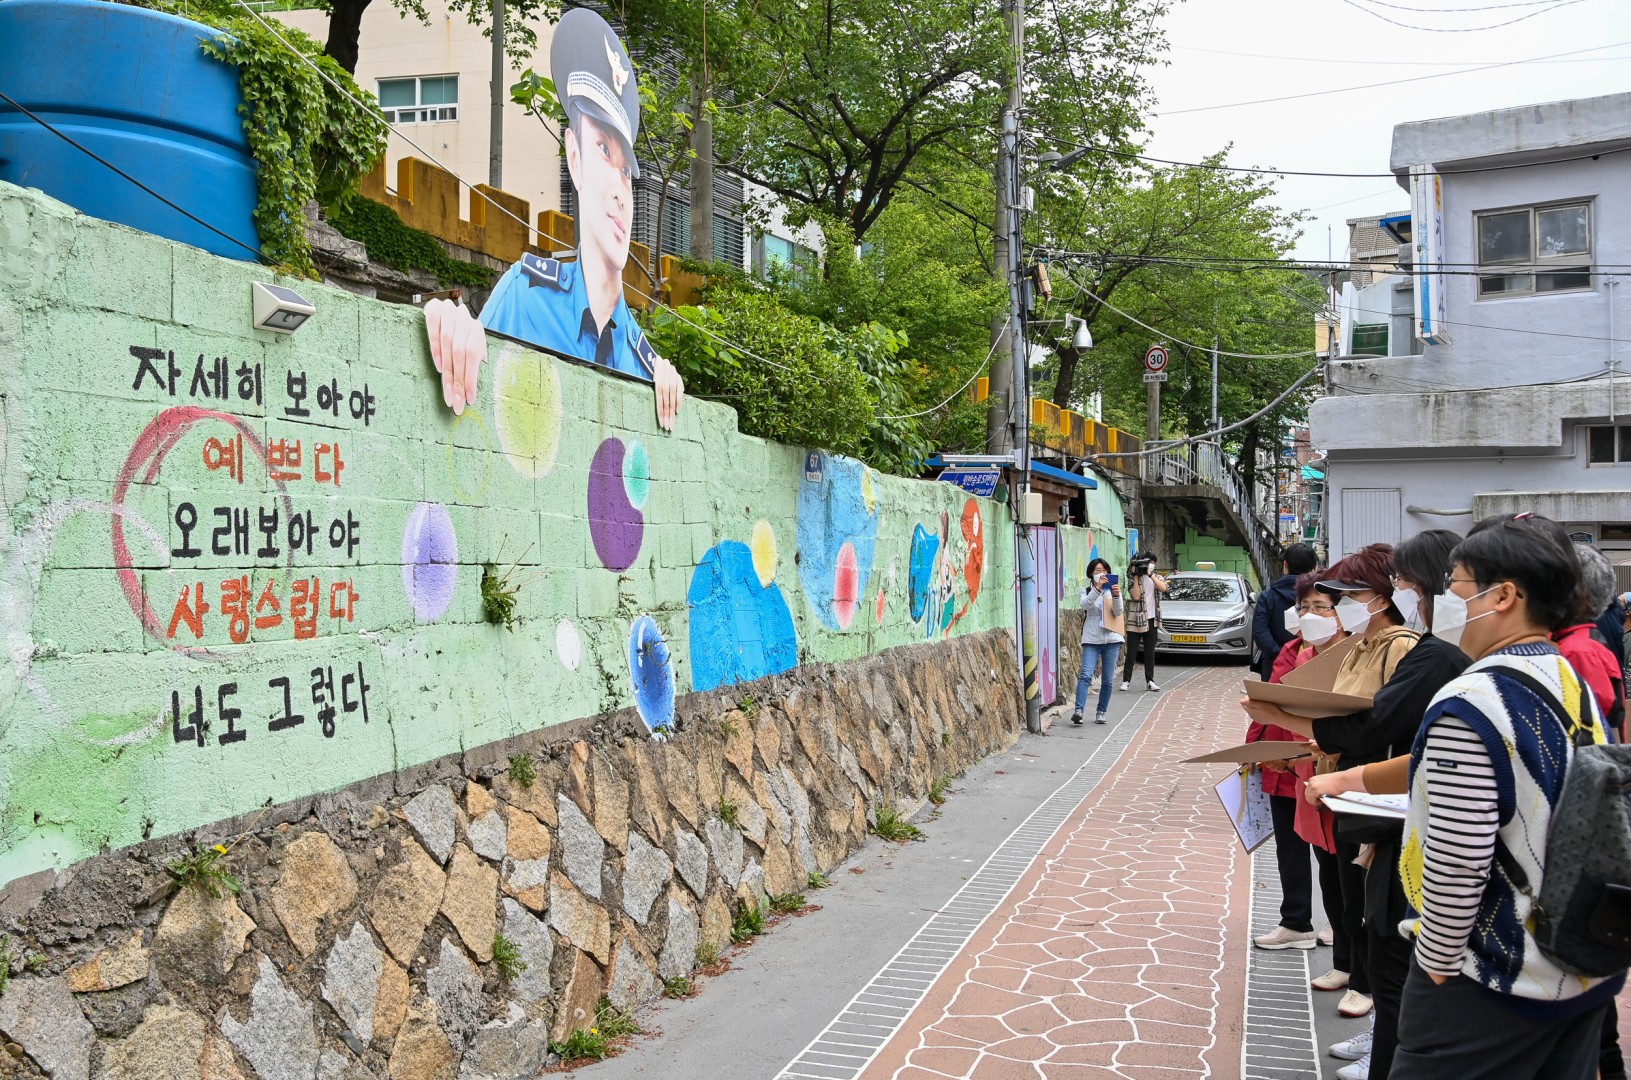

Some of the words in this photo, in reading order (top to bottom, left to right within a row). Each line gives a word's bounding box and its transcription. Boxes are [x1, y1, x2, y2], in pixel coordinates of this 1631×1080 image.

[129, 345, 264, 405] 자세히
[285, 369, 376, 426] 보아야
[1150, 354, 1163, 365] 30
[203, 433, 345, 486] 예쁘다
[810, 453, 819, 468] 67
[167, 574, 359, 644] 사랑스럽다
[172, 683, 247, 748] 너도
[268, 661, 371, 739] 그렇다
